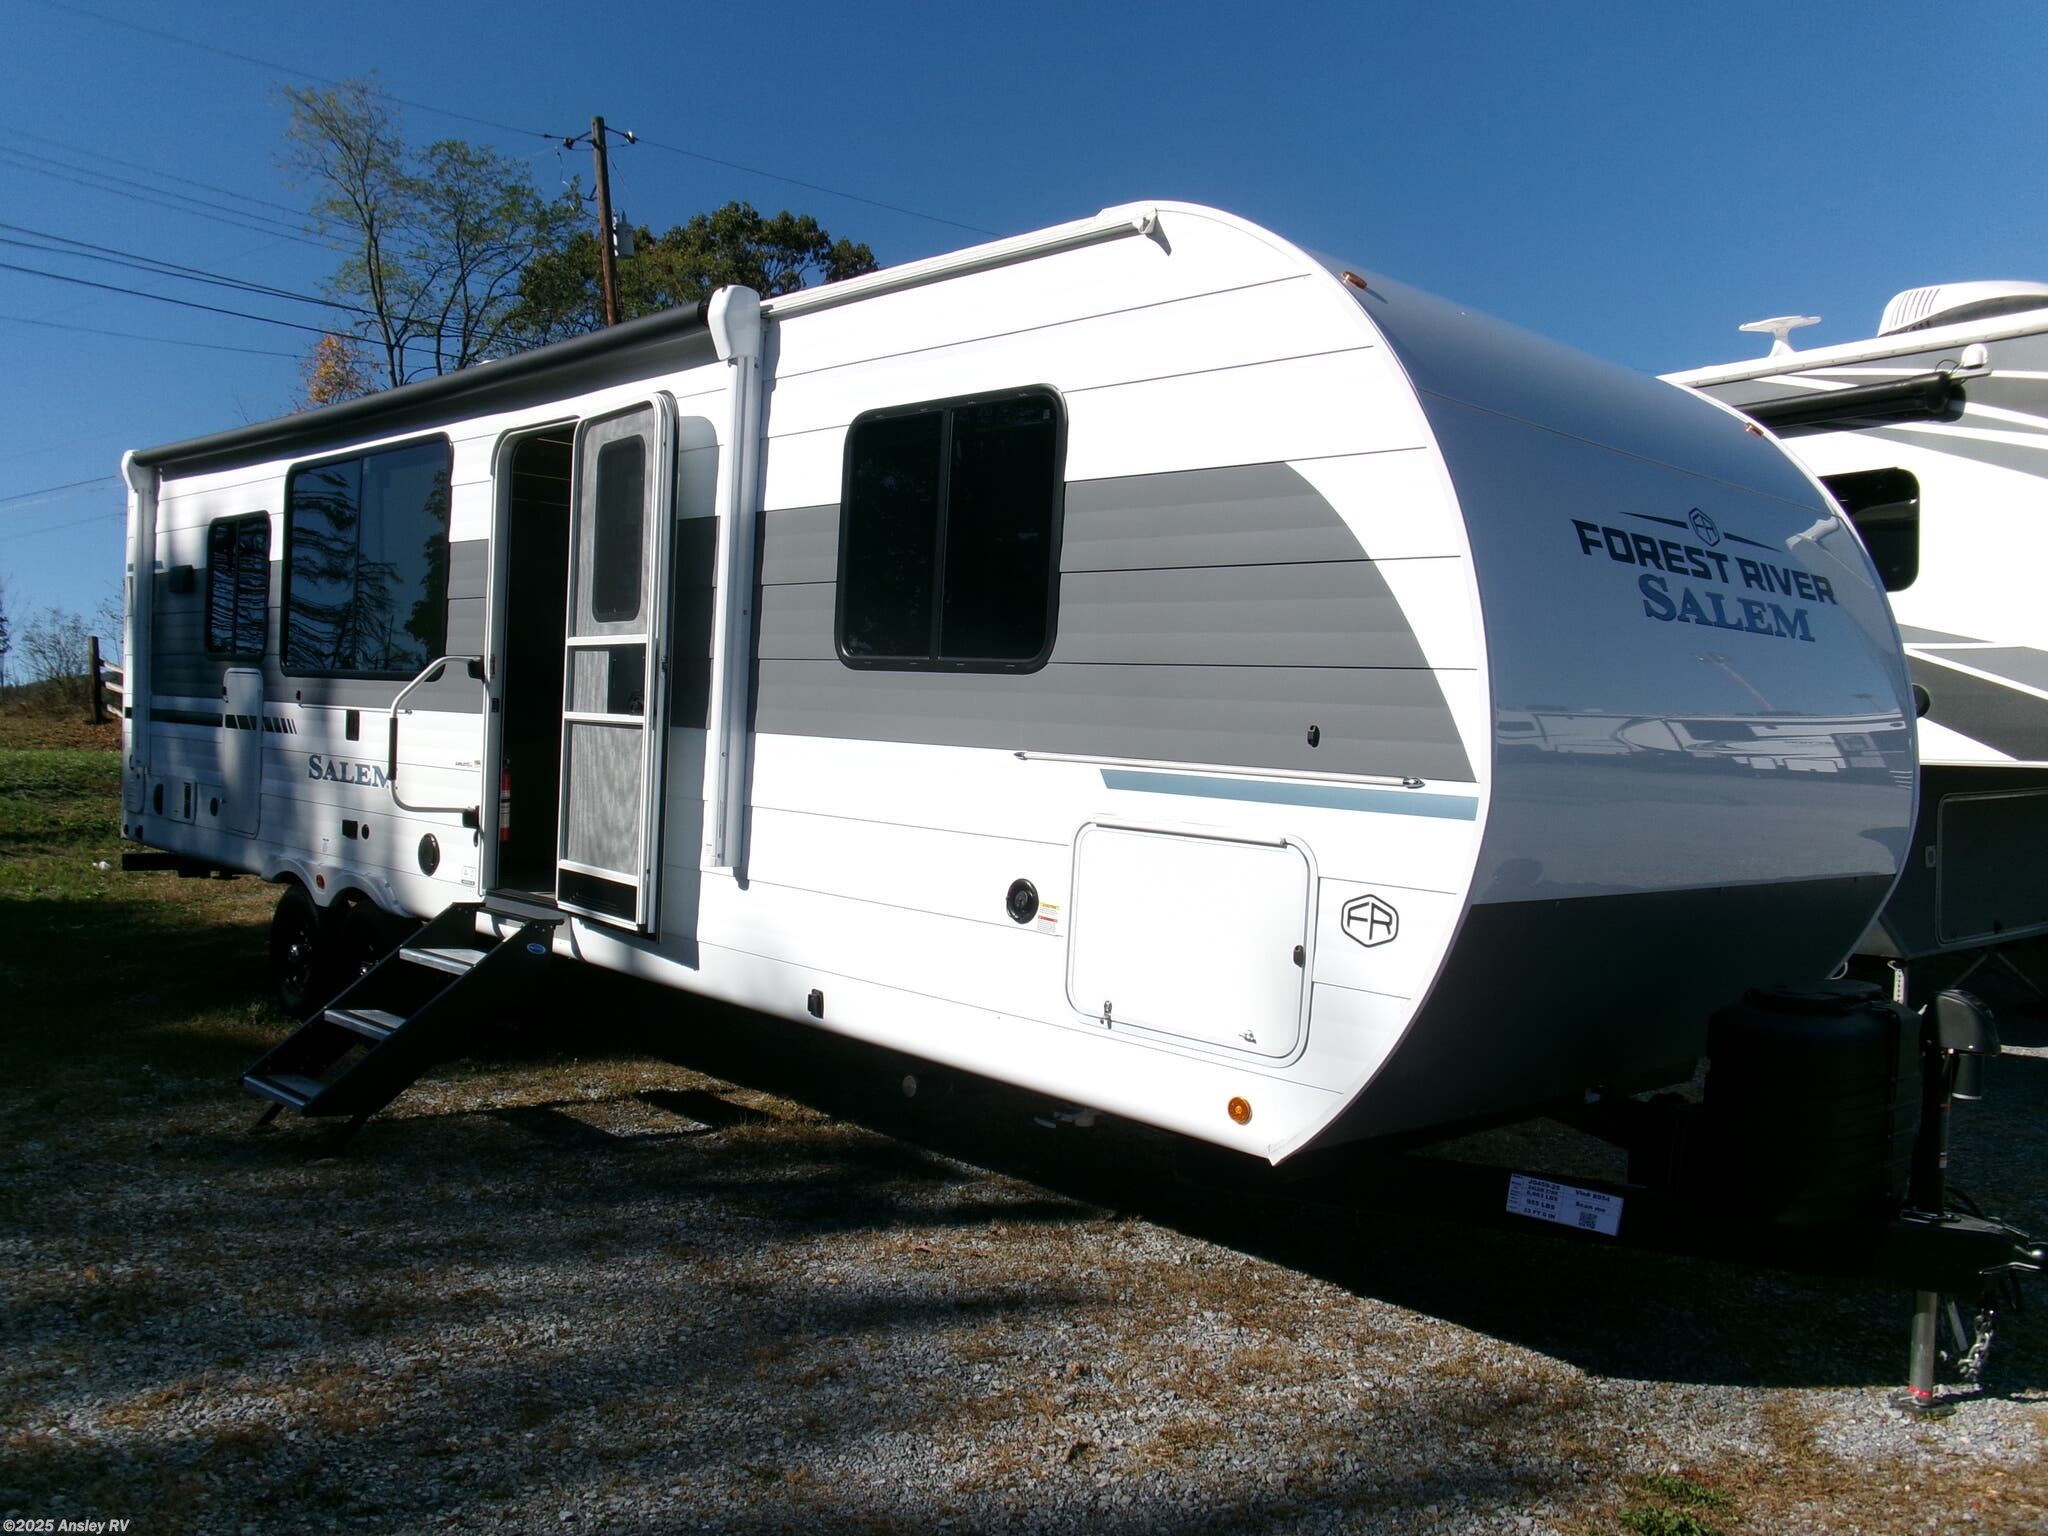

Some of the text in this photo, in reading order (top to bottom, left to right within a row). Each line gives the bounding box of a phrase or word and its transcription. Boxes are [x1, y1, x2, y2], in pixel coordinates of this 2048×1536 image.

[1571, 519, 1838, 605] FOREST RIVER
[1637, 573, 1816, 642] SALEM
[1347, 902, 1392, 940] FR
[1541, 1202, 1556, 1210] LBS
